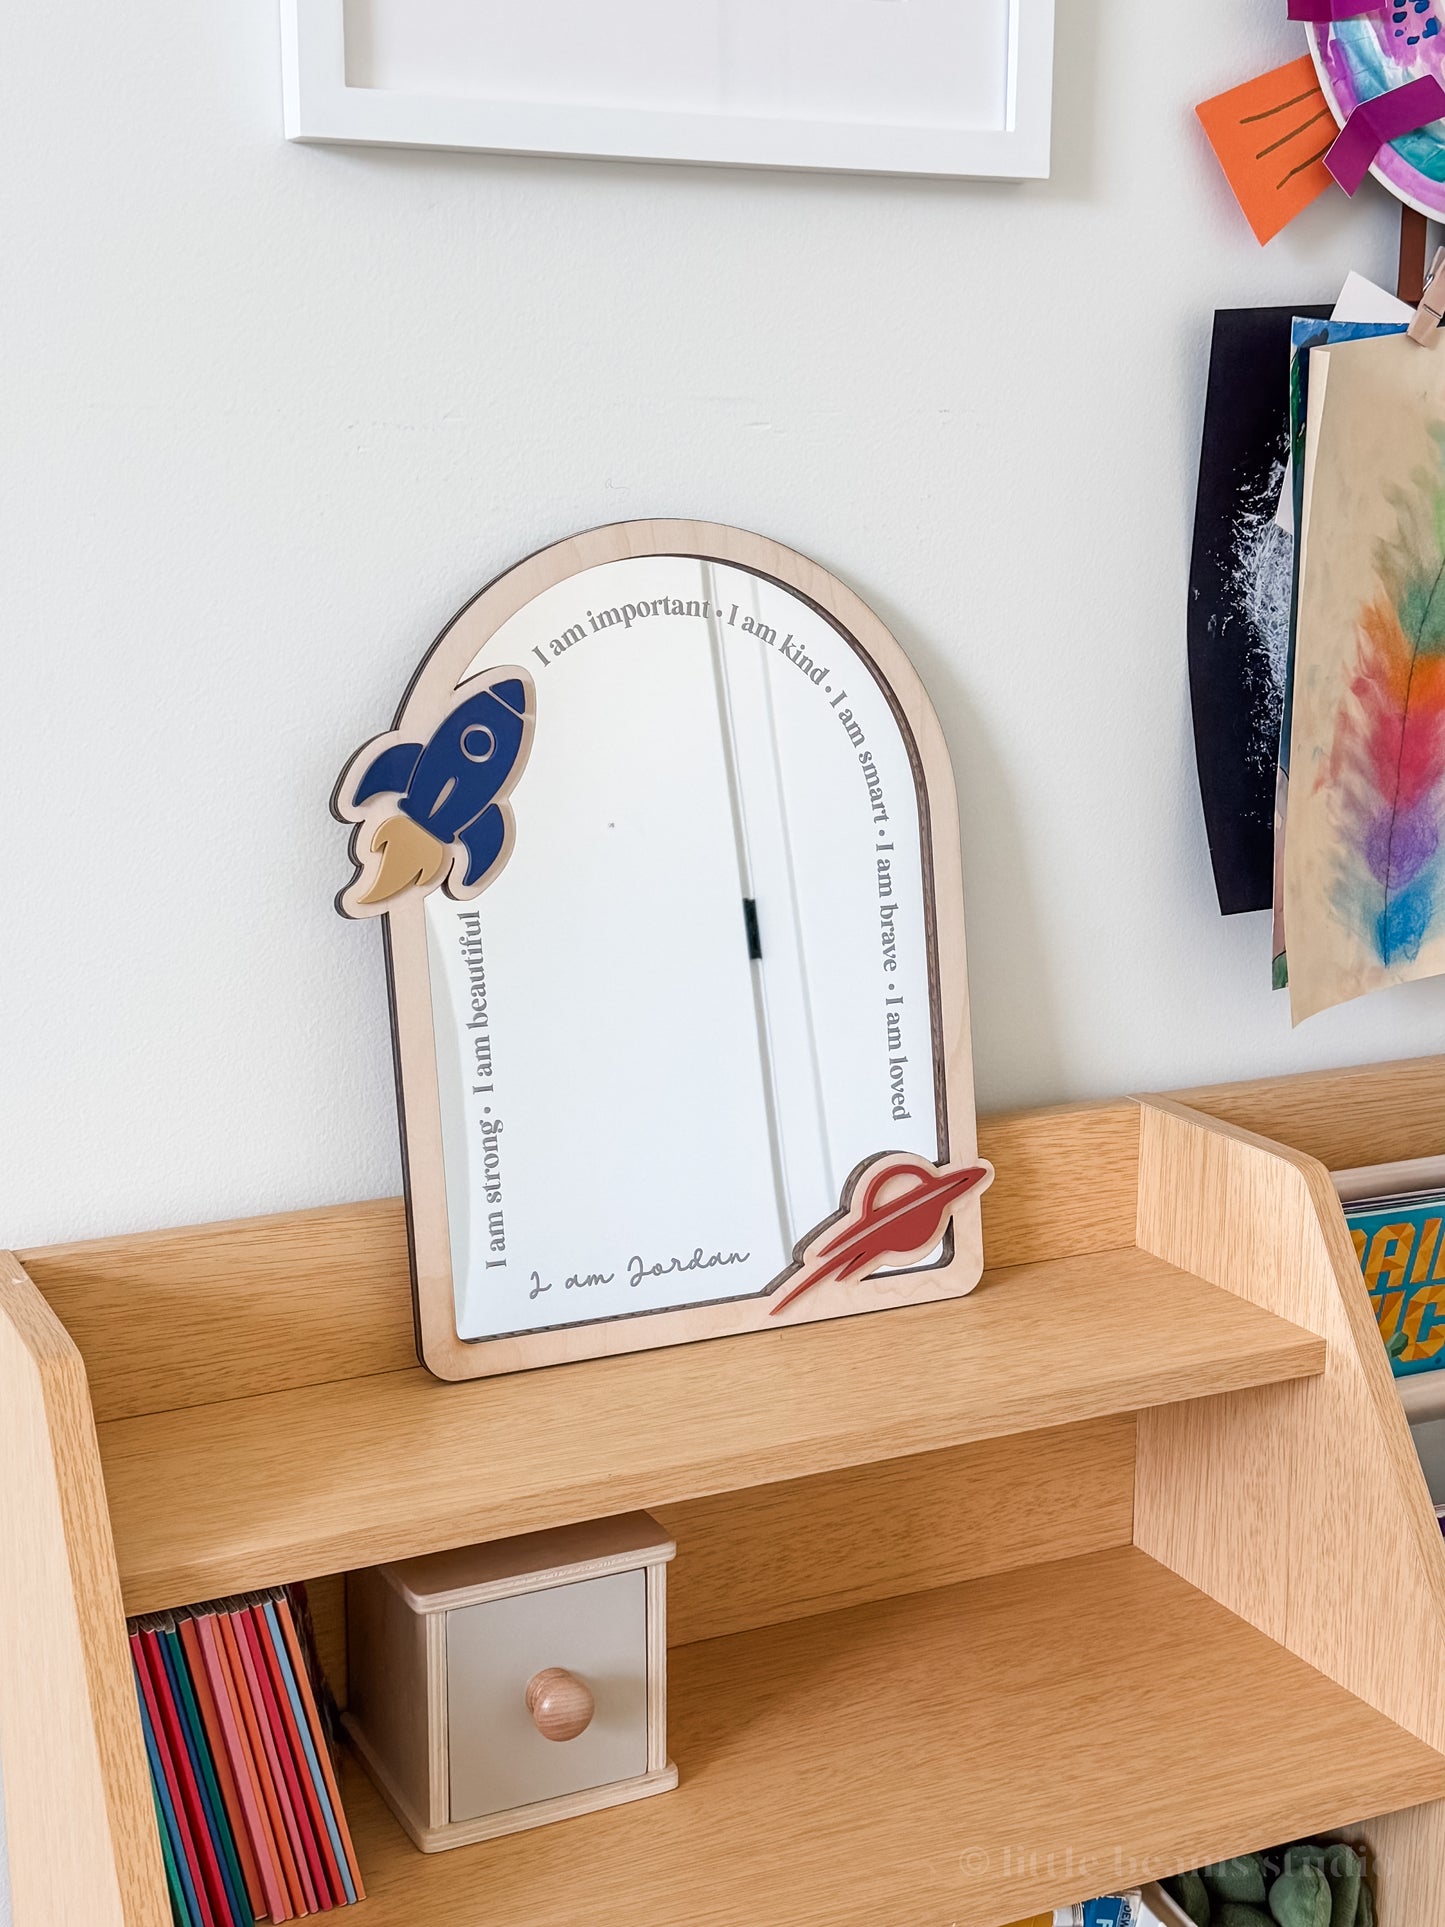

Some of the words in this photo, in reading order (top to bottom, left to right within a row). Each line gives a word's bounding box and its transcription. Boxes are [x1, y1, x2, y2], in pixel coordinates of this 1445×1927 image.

[587, 596, 712, 633] important
[727, 603, 740, 627] I
[741, 617, 777, 647] am
[531, 645, 552, 667] I
[550, 624, 588, 656] am
[778, 634, 831, 686] kind
[829, 689, 849, 709] I
[838, 708, 866, 749] am
[859, 750, 890, 825] smart
[876, 841, 895, 852] I
[877, 858, 893, 899] am
[880, 902, 898, 973] brave
[457, 909, 490, 1031] beautiful
[886, 995, 904, 1006] I
[887, 1012, 902, 1052] am
[474, 1034, 493, 1077] am
[472, 1083, 494, 1095] I
[889, 1055, 912, 1122] loved
[479, 1118, 504, 1204] strong
[488, 1209, 507, 1252] am
[485, 1258, 508, 1270] I
[529, 1270, 553, 1300] I
[564, 1272, 615, 1290] am
[626, 1247, 751, 1288] Jordan
